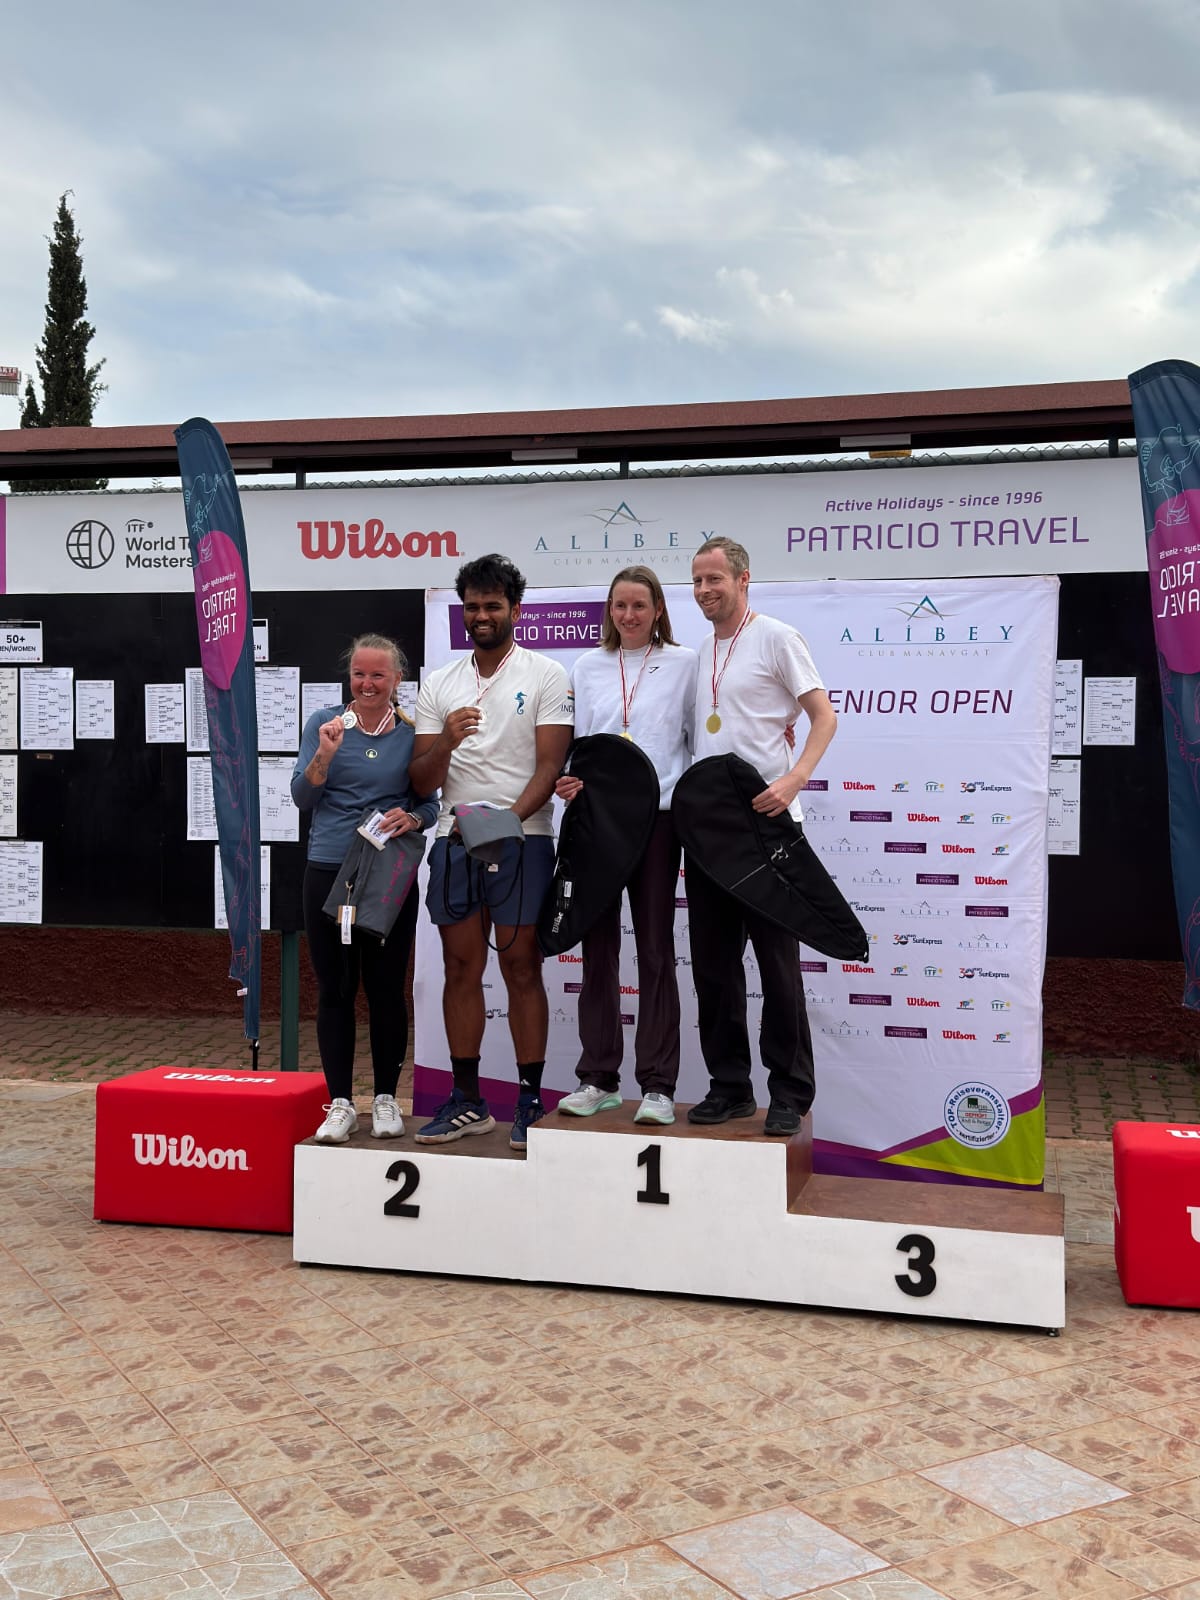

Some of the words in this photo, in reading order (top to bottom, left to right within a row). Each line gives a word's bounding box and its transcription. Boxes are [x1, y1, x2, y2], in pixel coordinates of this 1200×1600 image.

[825, 499, 873, 512] Active
[877, 496, 944, 512] Holidays
[959, 494, 1000, 507] since
[1005, 491, 1043, 505] 1996
[297, 518, 460, 560] Wilson
[787, 522, 939, 553] PATRICIO
[950, 516, 1090, 547] TRAVEL
[125, 536, 175, 551] World
[126, 554, 193, 568] Masters
[553, 557, 592, 566] CLUB
[547, 611, 566, 619] since
[569, 610, 587, 618] 1996
[6, 634, 26, 644] 50+
[858, 648, 895, 657] CLUB
[903, 648, 991, 658] MANAVGAT
[828, 690, 918, 713] ENIOR
[930, 689, 1013, 713] OPEN
[843, 781, 876, 790] Wilson
[907, 812, 941, 822] Wilson
[942, 844, 976, 853] Wilson
[975, 875, 1008, 886] Wilson
[558, 954, 583, 963] Wilso
[842, 963, 875, 973] Wilson
[907, 997, 941, 1007] Wilson
[942, 1030, 977, 1040] Wilson
[163, 1072, 276, 1083] Wilson
[132, 1133, 249, 1171] Wilson
[636, 1144, 670, 1205] 1
[383, 1160, 421, 1219] 2
[894, 1234, 938, 1298] 3
